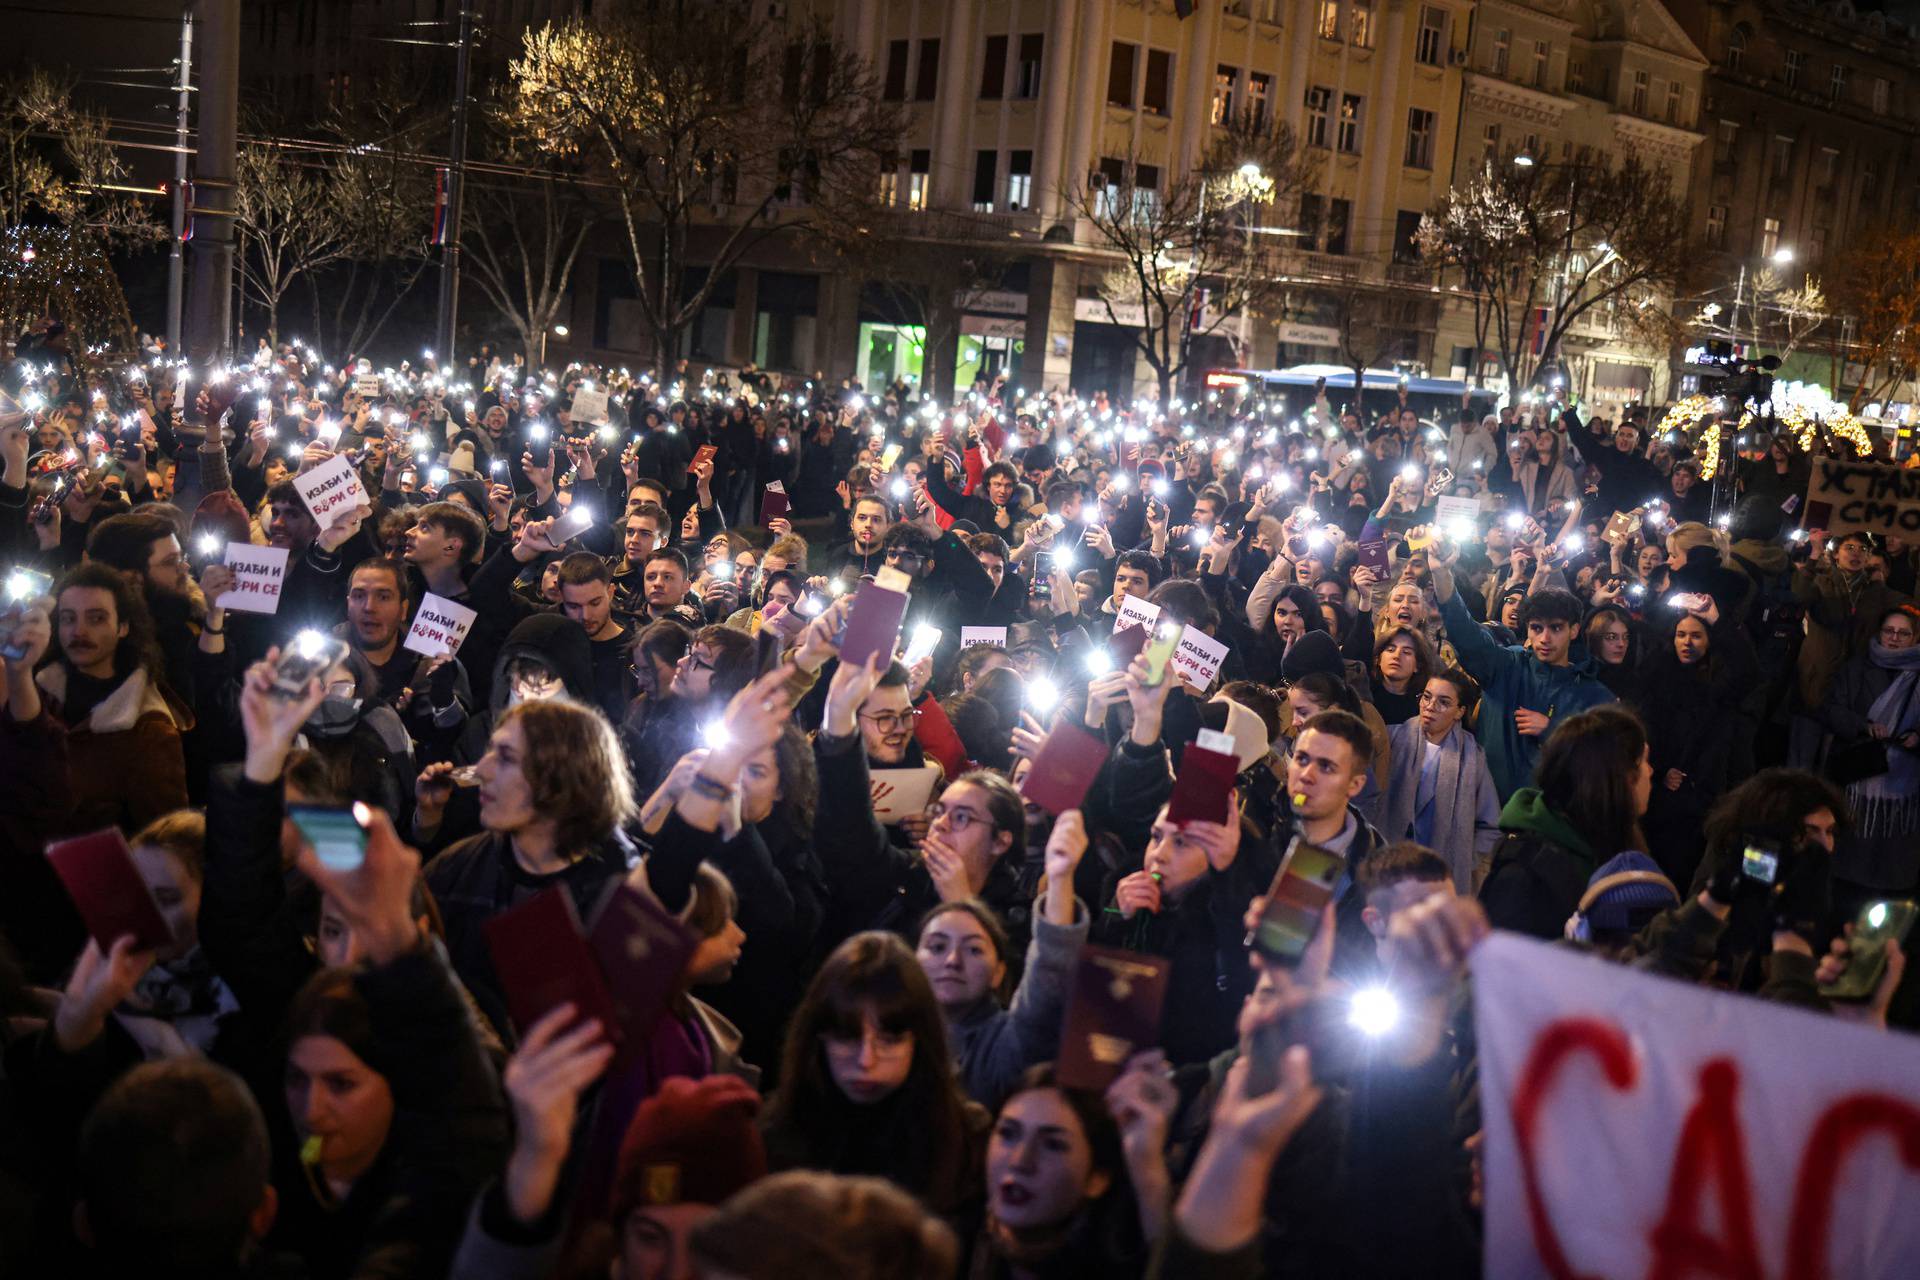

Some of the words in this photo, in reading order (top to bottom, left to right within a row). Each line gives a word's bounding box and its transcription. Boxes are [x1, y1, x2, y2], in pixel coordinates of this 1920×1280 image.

[306, 475, 342, 499] ИЗАЂИ
[343, 469, 353, 480] И
[1840, 500, 1920, 531] СМО
[271, 567, 281, 577] И
[263, 584, 279, 595] СЕ
[421, 610, 455, 629] ИЗАЂИ
[456, 623, 466, 634] И
[1123, 608, 1147, 622] ИЗАЂИ
[1147, 618, 1154, 626] И
[445, 635, 460, 649] СЕ
[1181, 640, 1211, 661] ИЗАЂИ
[1211, 657, 1220, 667] И
[1200, 667, 1214, 679] СЕ
